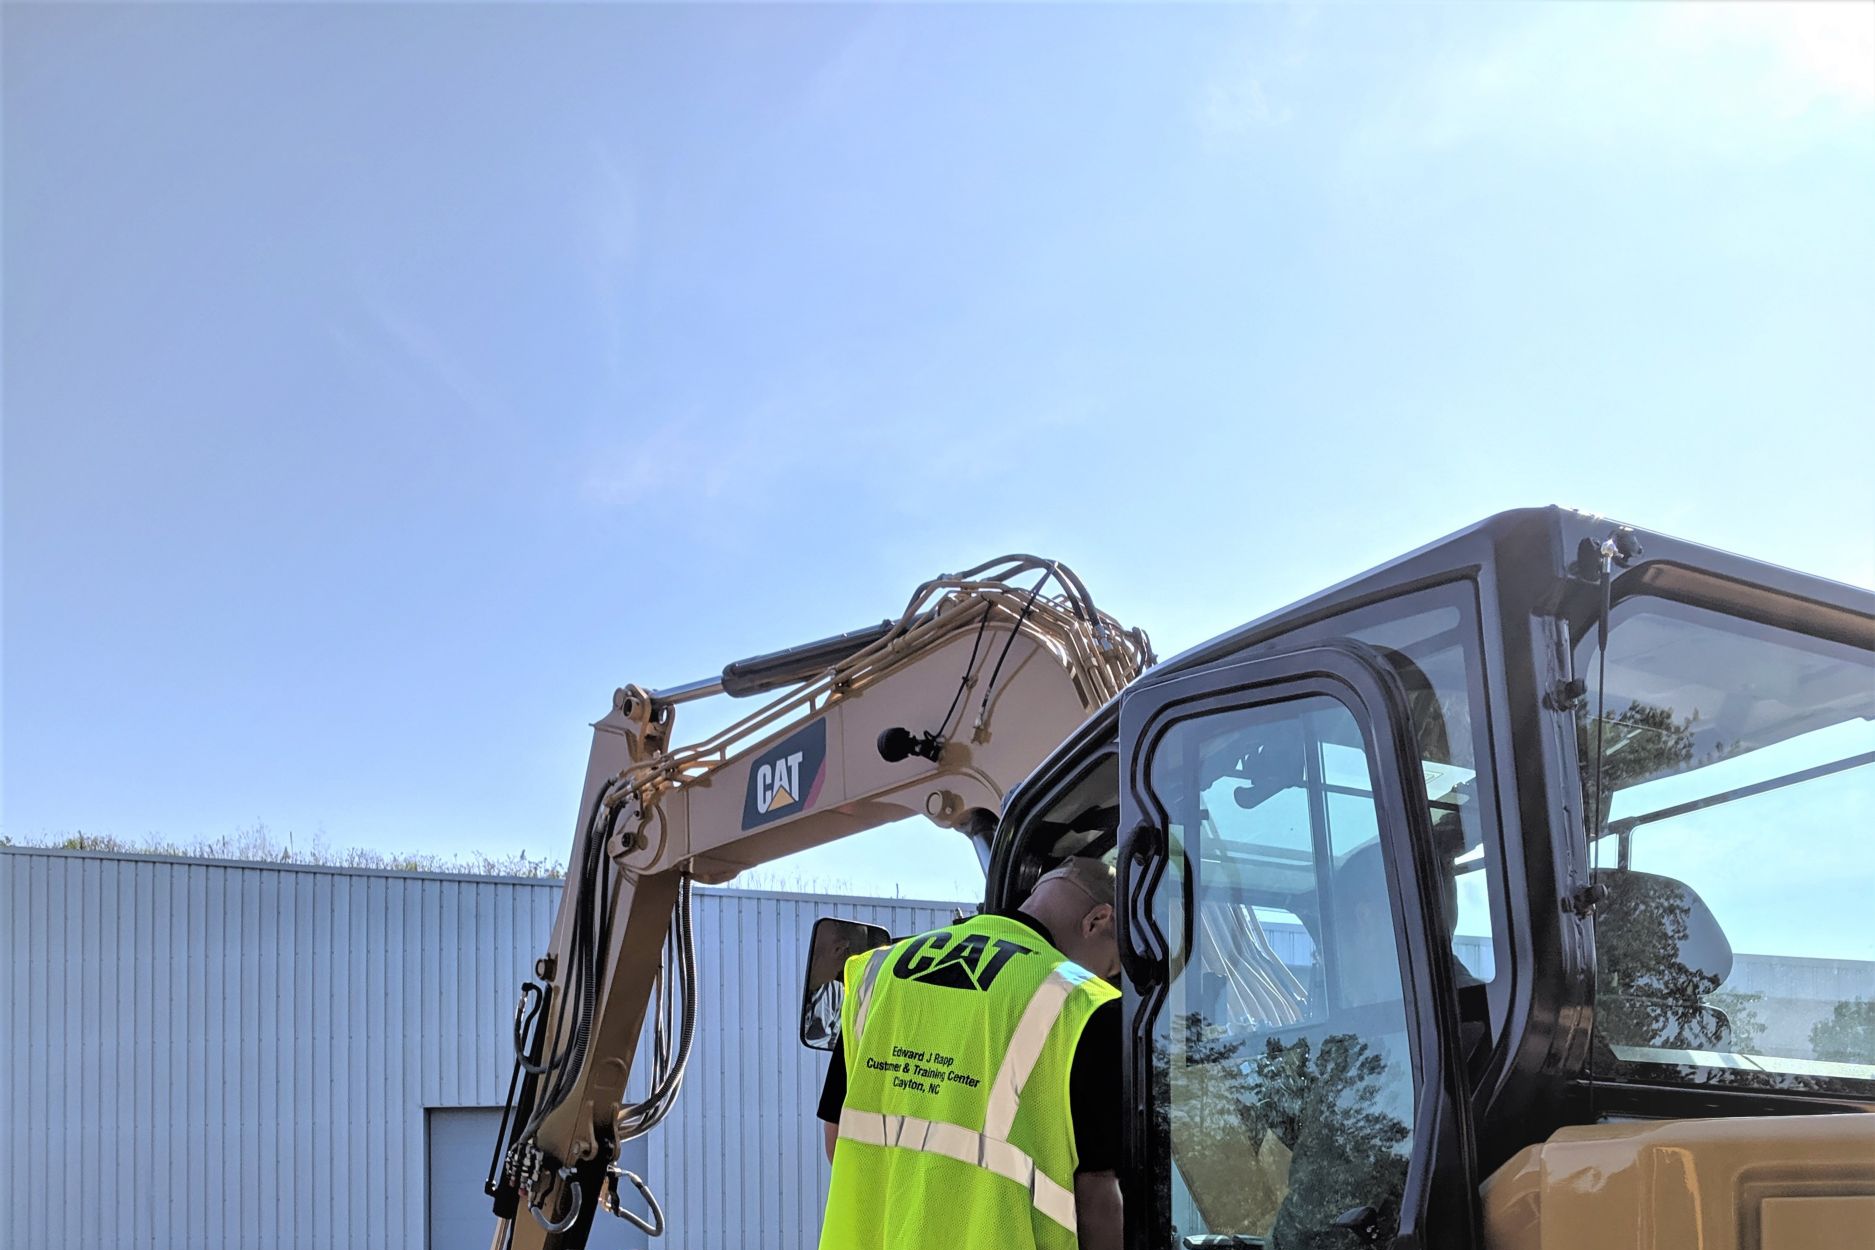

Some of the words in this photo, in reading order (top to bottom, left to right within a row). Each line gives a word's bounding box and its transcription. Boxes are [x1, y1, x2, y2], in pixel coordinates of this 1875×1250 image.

[757, 751, 803, 814] CAT
[893, 932, 1034, 992] CAT
[892, 1046, 925, 1062] Edward
[926, 1052, 933, 1063] J
[933, 1053, 954, 1067] Rapp
[866, 1057, 902, 1072] Custmer
[902, 1062, 911, 1073] &
[913, 1064, 946, 1083] Training
[947, 1070, 980, 1088] Center
[928, 1083, 941, 1095] NC
